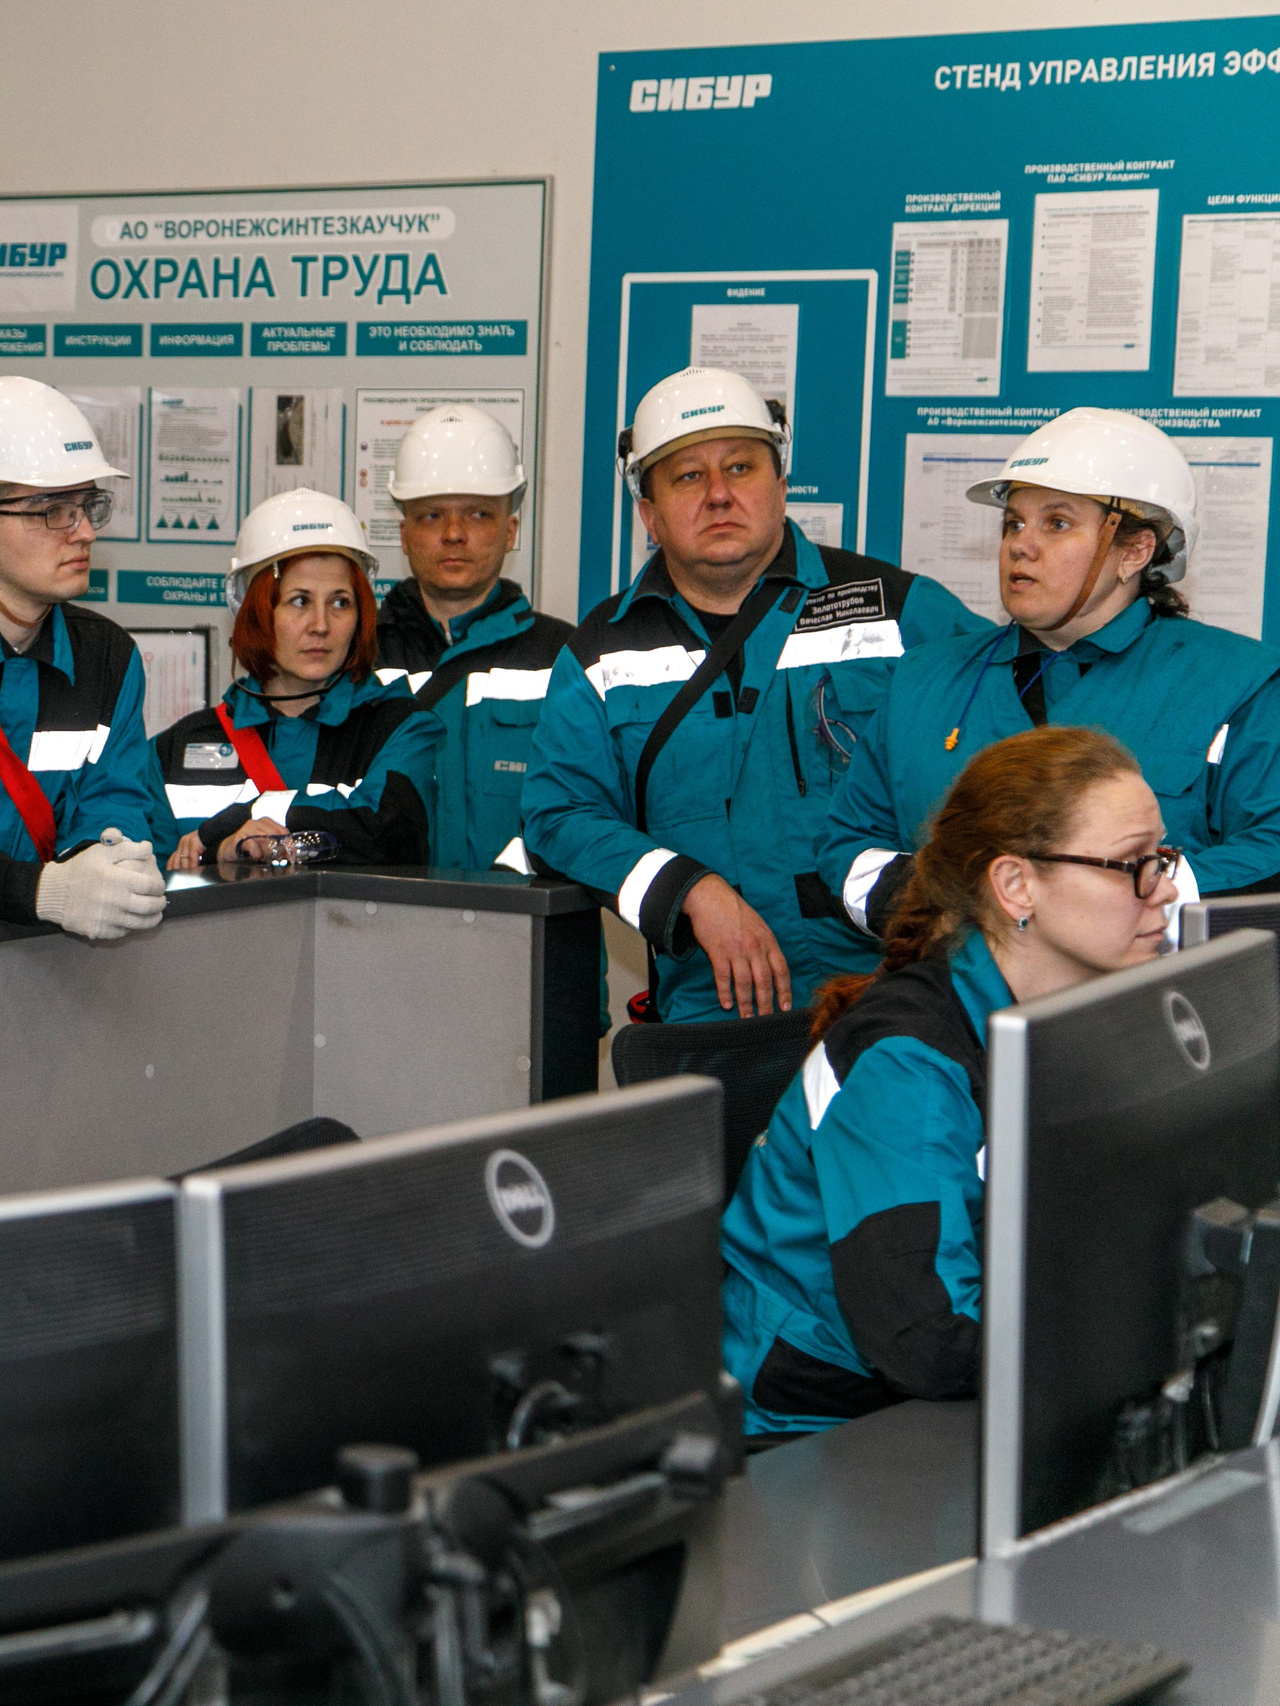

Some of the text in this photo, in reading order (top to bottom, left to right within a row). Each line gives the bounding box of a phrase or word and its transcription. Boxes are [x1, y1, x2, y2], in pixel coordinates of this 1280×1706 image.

[934, 62, 1022, 92] СТЕНД
[1028, 51, 1216, 86] УПРАВЛЕНИЯ
[629, 73, 773, 113] СИБУР
[1024, 159, 1175, 174] ПРОИЗВОДСТВЕННЫЙ КОНТРАКТ
[1047, 173, 1066, 183] ПАО
[1067, 172, 1105, 183] «СИБУР
[905, 190, 1001, 204] ПРОИЗВОДСТВЕННЫЙ
[1207, 193, 1280, 206] ЦЕЛИ ФУНКЦИ
[905, 202, 1001, 213] КОНТРАКТ ДИРЕКЦИИ
[120, 219, 149, 240] АО
[90, 252, 448, 305] ОХРАНА ТРУДА
[726, 288, 766, 297] ВИДЕНИЕ
[261, 326, 336, 339] АКТУАЛЬНЫЕ
[368, 325, 516, 339] ЭТО НЕОБХОДИМО ЗНАТЬ
[65, 334, 132, 347] ИНСТРУКЦИИ
[159, 334, 235, 347] ИНФОРМАЦИЯ
[267, 340, 331, 352] ПРОБЛЕМЫ
[399, 340, 483, 353] И СОБЛЮДАТЬ
[681, 404, 725, 420] СИБУР
[917, 406, 1061, 417] ПРОИЗВОДСТВЕННЫЙ КОНТРАКТ
[1211, 407, 1262, 418] КОНТРАКТ
[927, 417, 940, 426] АО
[63, 441, 93, 452] СИБУР
[1009, 457, 1050, 469] СИБУР
[146, 576, 218, 590] СОБЛЮДАЙТЕ
[162, 590, 207, 602] ОХРАНЫ
[812, 597, 865, 615] Золототрубов
[835, 605, 879, 618] Николаевич
